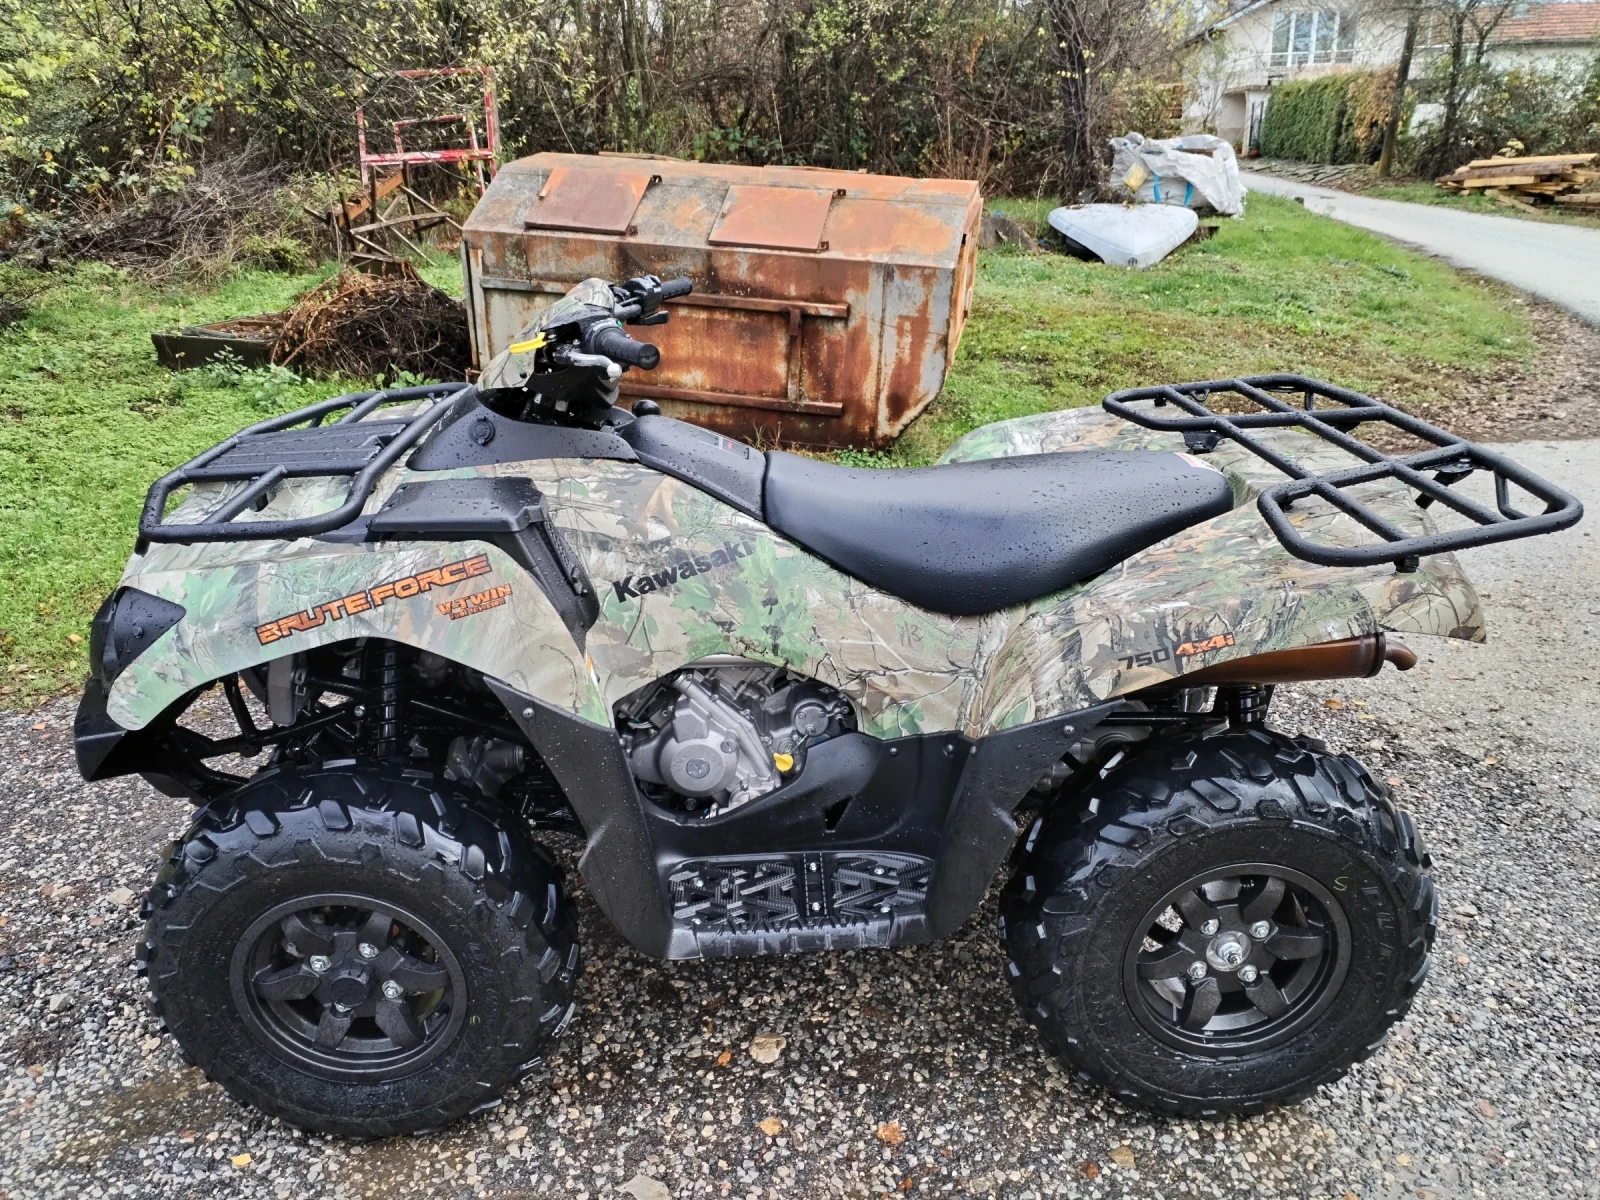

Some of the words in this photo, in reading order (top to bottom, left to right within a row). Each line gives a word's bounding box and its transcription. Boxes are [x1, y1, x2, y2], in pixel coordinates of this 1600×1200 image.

[612, 535, 754, 603] Kawasaki
[254, 591, 372, 646] BRUTE
[367, 553, 493, 609] FORCE
[436, 583, 513, 615] V-TWIN
[1117, 648, 1171, 671] 750
